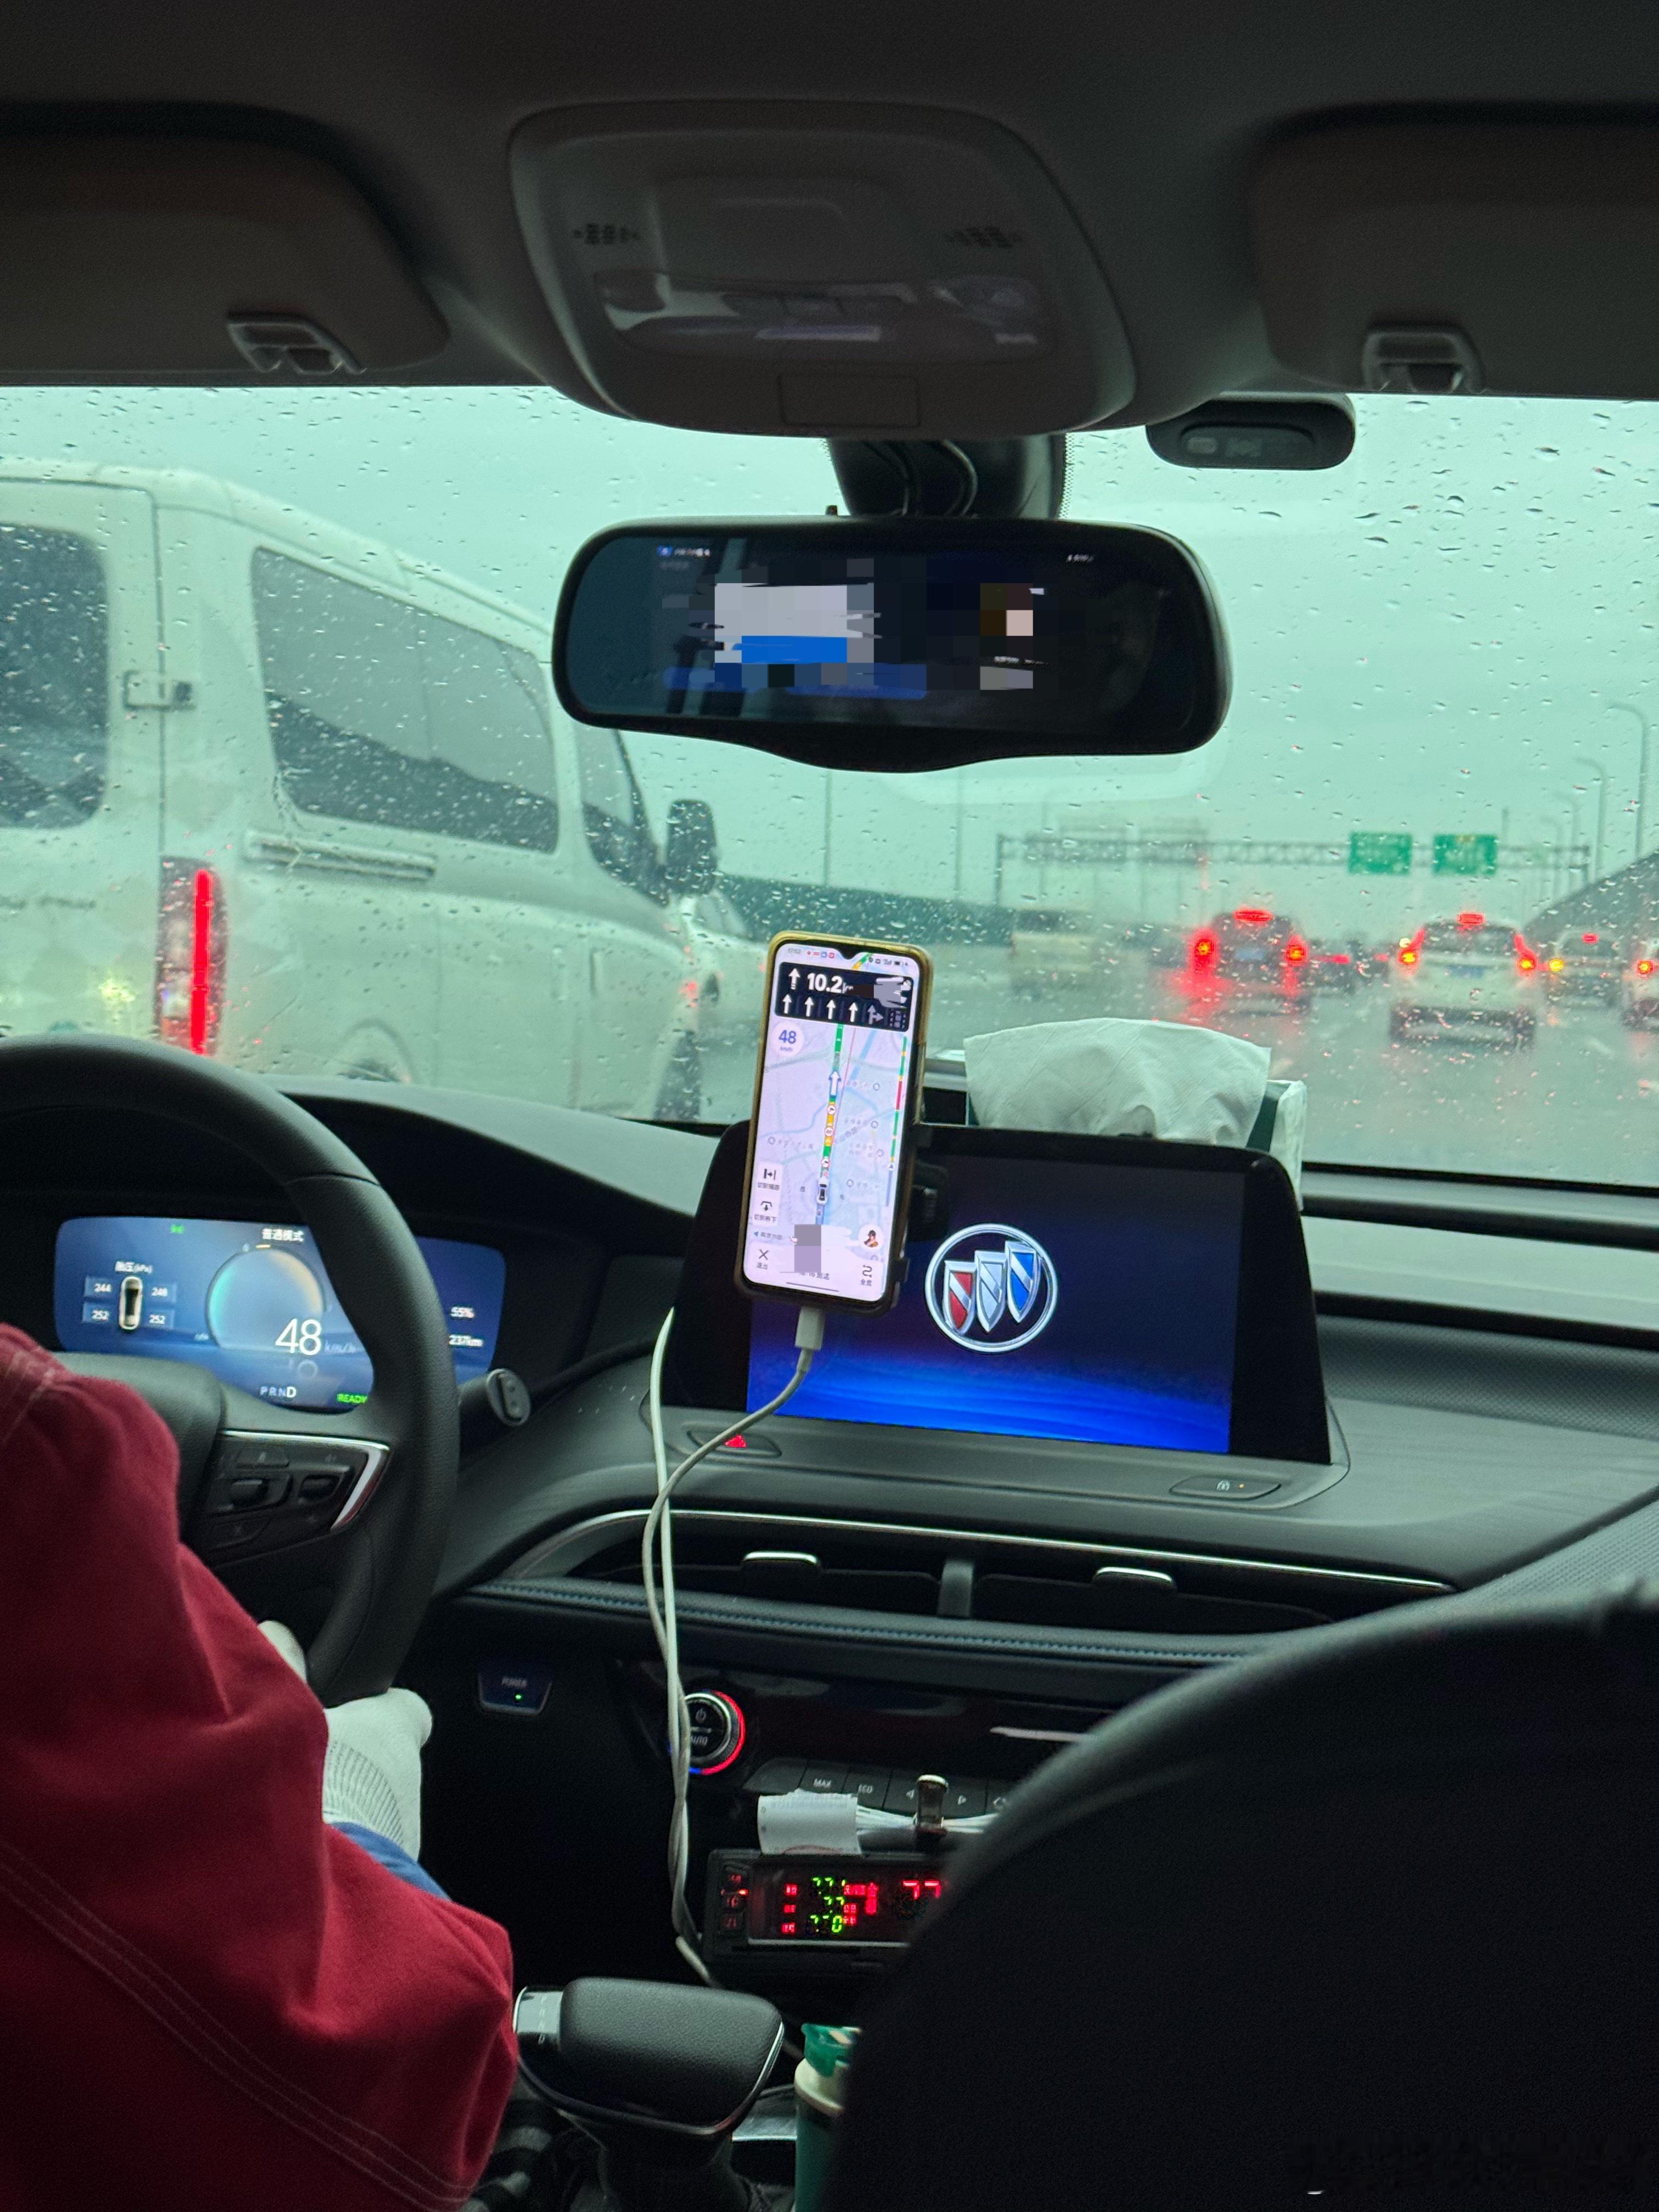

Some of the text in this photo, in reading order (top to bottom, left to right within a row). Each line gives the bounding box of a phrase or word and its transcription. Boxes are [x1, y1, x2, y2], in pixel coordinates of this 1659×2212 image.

[807, 973, 842, 994] 10.2
[778, 1030, 796, 1044] 48
[262, 1228, 304, 1242] 普通模式
[91, 1310, 109, 1321] 252
[149, 1314, 166, 1324] 252
[275, 1318, 323, 1356] 48
[336, 1392, 368, 1404] READY
[814, 1778, 831, 1788] MAX
